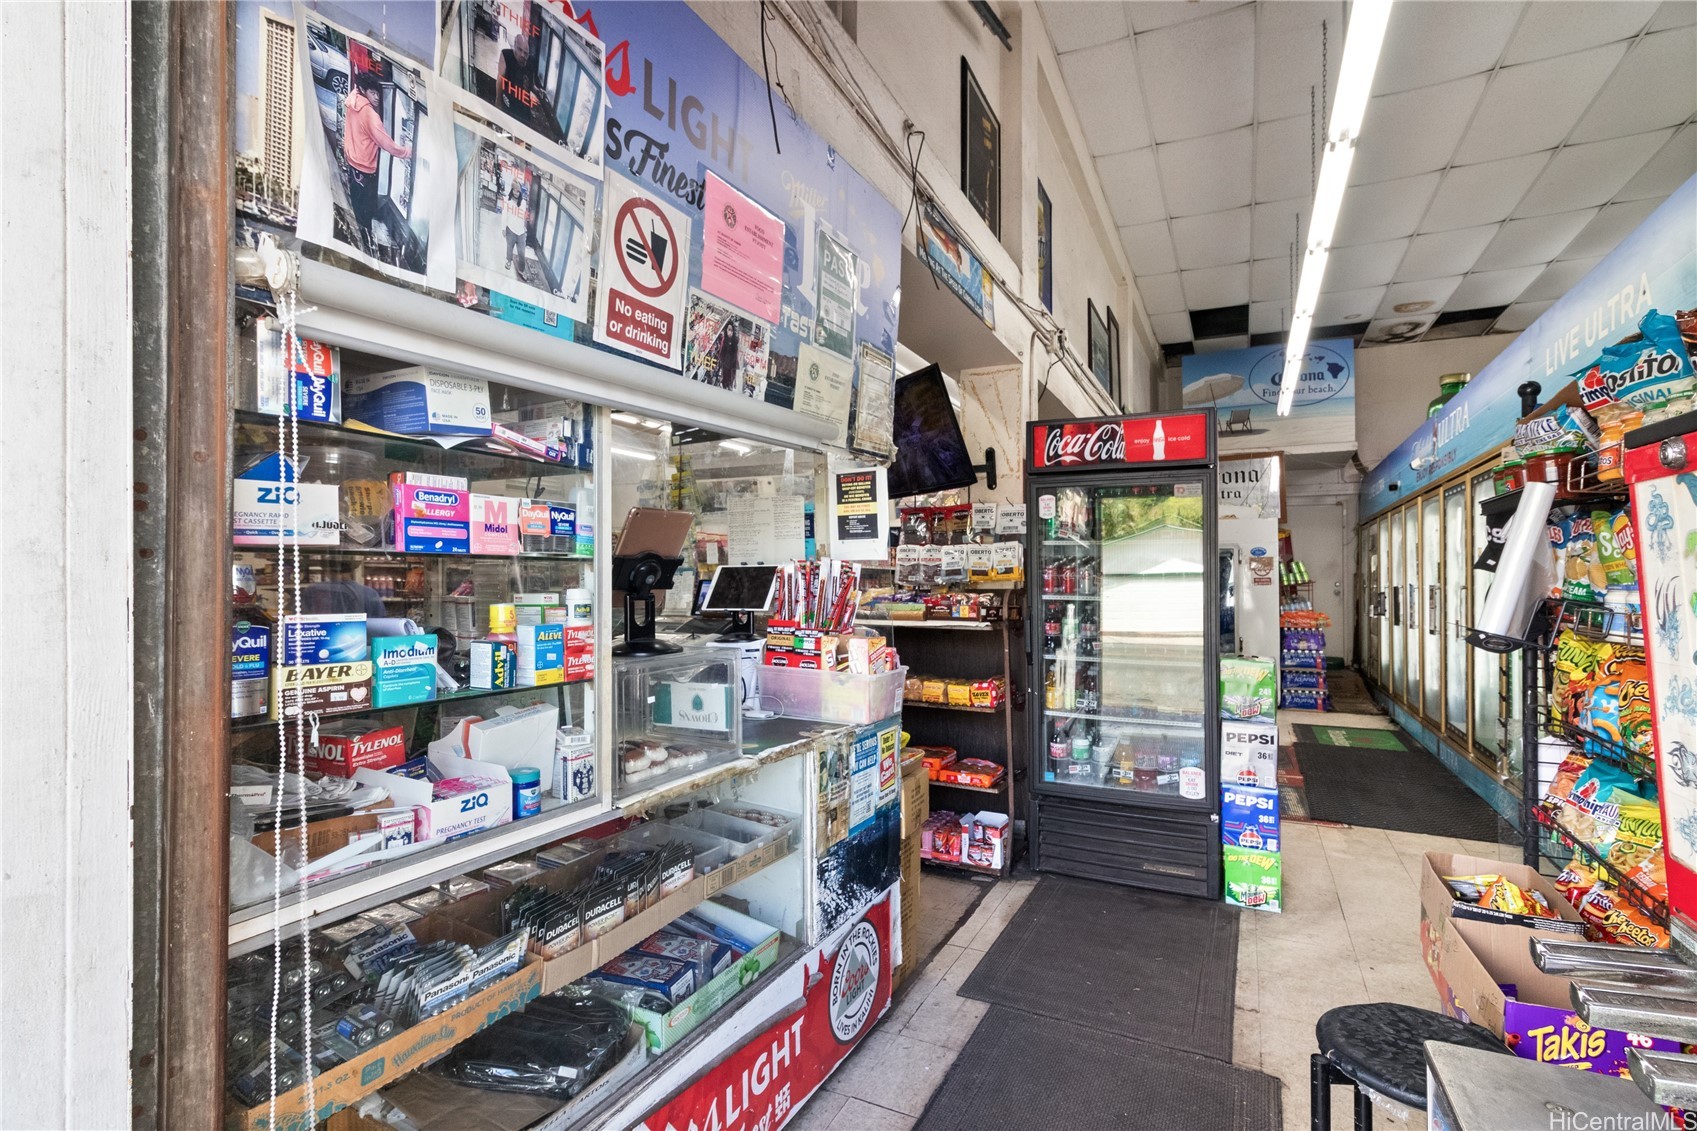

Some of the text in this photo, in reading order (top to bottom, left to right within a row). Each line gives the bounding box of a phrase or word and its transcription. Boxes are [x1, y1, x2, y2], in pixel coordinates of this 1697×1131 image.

[500, 2, 541, 40] THIEF
[499, 75, 540, 109] THIEF
[643, 57, 753, 184] LIGHT
[623, 129, 706, 212] Finest
[615, 297, 668, 333] No eating
[1545, 272, 1652, 376] LIVE ULTRA
[609, 319, 669, 354] or drinking
[429, 378, 485, 393] DISPOSABLE 3-PLY
[1270, 371, 1325, 387] Cona
[310, 376, 326, 418] NyQuil
[1262, 383, 1337, 398] Fin beach.
[475, 407, 486, 416] 50
[1437, 400, 1470, 448] ULTRA
[1044, 424, 1125, 466] Coca-Cola
[1134, 438, 1150, 446] enjoy
[1221, 469, 1260, 485] ona
[418, 491, 457, 506] Benadryl
[1221, 490, 1242, 499] tra
[422, 507, 456, 518] ALLERGY
[484, 500, 508, 522] M
[522, 508, 575, 522] DayQuil NyQuil
[484, 523, 508, 534] Midol
[287, 629, 327, 638] Laxative
[537, 631, 563, 641] ALEVE
[232, 634, 267, 653] yQuil
[383, 645, 435, 660] Imodium
[232, 653, 261, 663] EVERE
[285, 664, 351, 682] BAYER
[383, 667, 418, 676] Anti-Diarrheal
[494, 651, 504, 688] Advil
[317, 684, 345, 694] ASPIRIN
[286, 733, 403, 762] TYLNOL TYLENOL
[862, 736, 877, 750] SERIOUS
[1226, 732, 1275, 745] PEPSI
[352, 755, 387, 768] Extra Strength
[868, 754, 877, 767] HELP
[883, 757, 893, 770] We
[1257, 751, 1268, 760] 36
[881, 766, 895, 782] Card
[460, 792, 489, 813] ZiQ
[1224, 791, 1274, 810] PEPSI
[435, 815, 487, 836] PREGNANCY TEST
[1258, 814, 1269, 824] 36
[661, 858, 692, 881] DURACELL
[1248, 854, 1276, 871] DEW
[585, 896, 623, 921] DURACELL
[545, 917, 580, 941] DURACEL
[588, 910, 620, 929] POWER BOOST
[358, 932, 409, 961] Panasonic
[549, 936, 566, 949] POWER
[472, 951, 517, 980] Panasonic
[832, 926, 878, 1006] BORN IN THE ROCKIES
[423, 975, 470, 1002] Panasoni
[841, 963, 870, 999] Coors
[846, 980, 866, 1005] LIGHT
[451, 996, 485, 1022] PRODUCT
[486, 990, 498, 1003] OF
[836, 988, 874, 1036] LIVES IN KALIHI
[392, 1034, 438, 1068] Hawaiian
[1527, 1025, 1606, 1063] Takis
[726, 1015, 804, 1129] LIGHT
